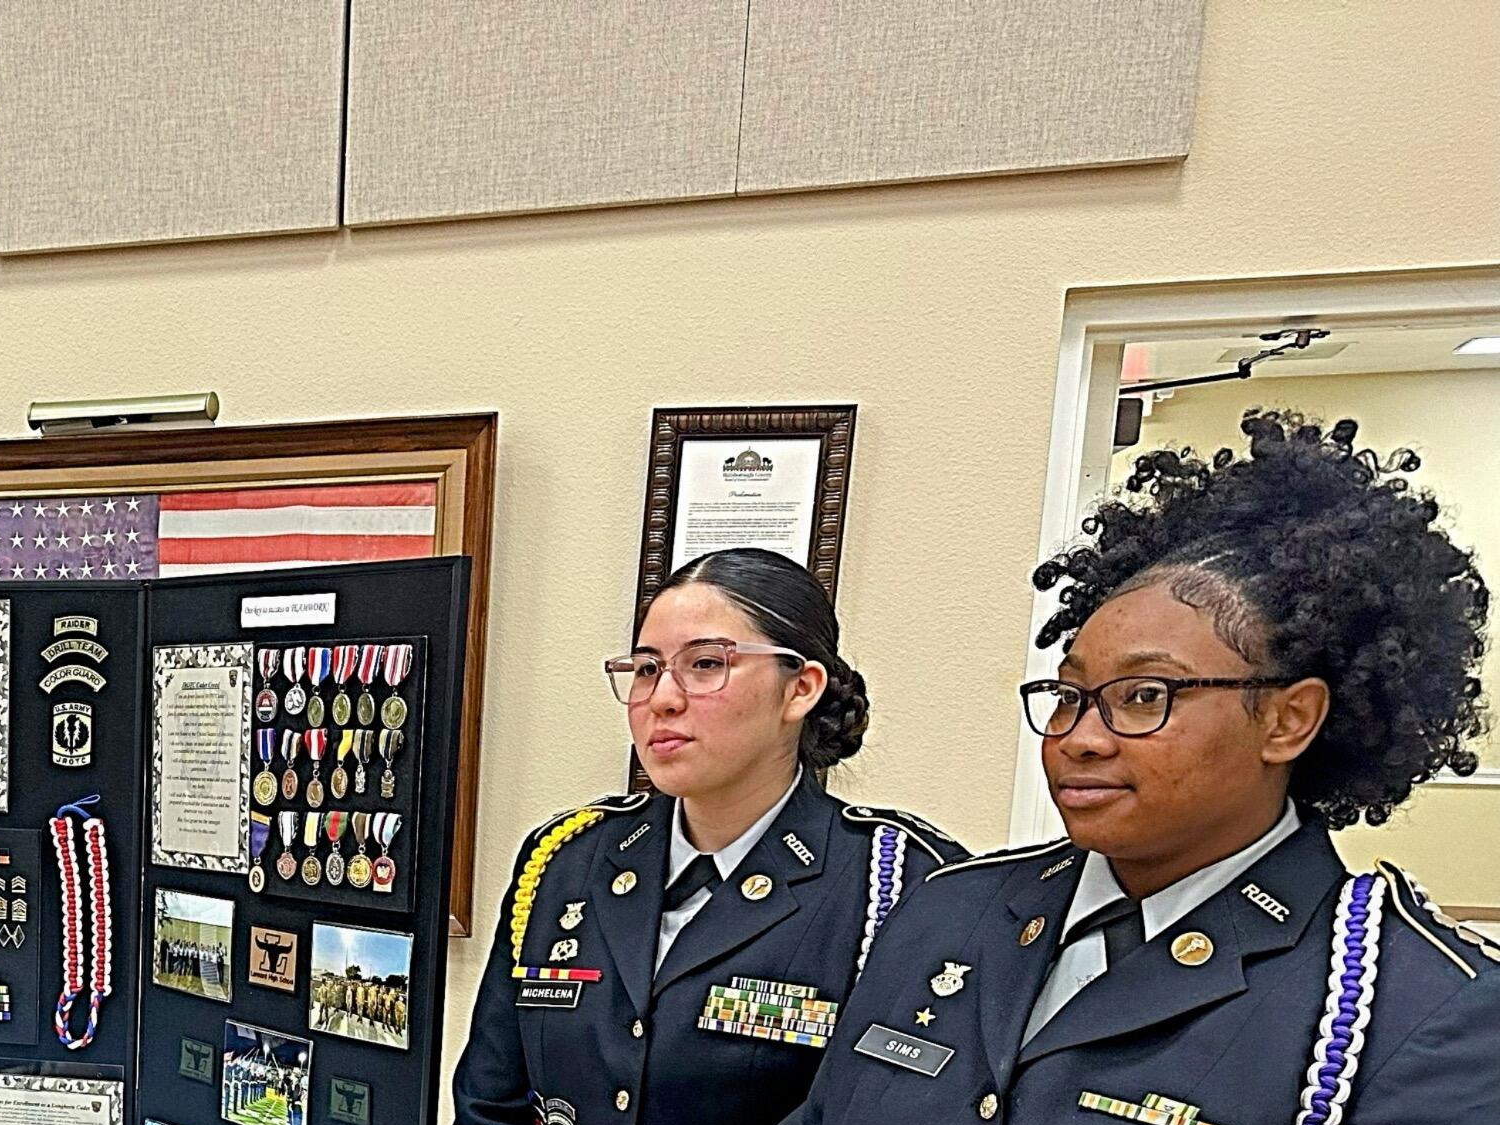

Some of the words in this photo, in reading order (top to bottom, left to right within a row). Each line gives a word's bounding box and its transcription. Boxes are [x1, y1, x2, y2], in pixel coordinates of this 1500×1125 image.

[61, 620, 91, 629] RAIDER
[48, 641, 74, 659] DRILL
[77, 640, 103, 659] TEAM
[44, 668, 72, 688] COLOR
[73, 668, 100, 687] GUARD
[69, 704, 90, 713] ARMY
[619, 823, 650, 851] ROTC
[783, 832, 815, 866] ROTC
[1240, 883, 1290, 923] ROTC
[522, 987, 573, 1000] MICHELENA
[885, 1040, 921, 1059] SIMS
